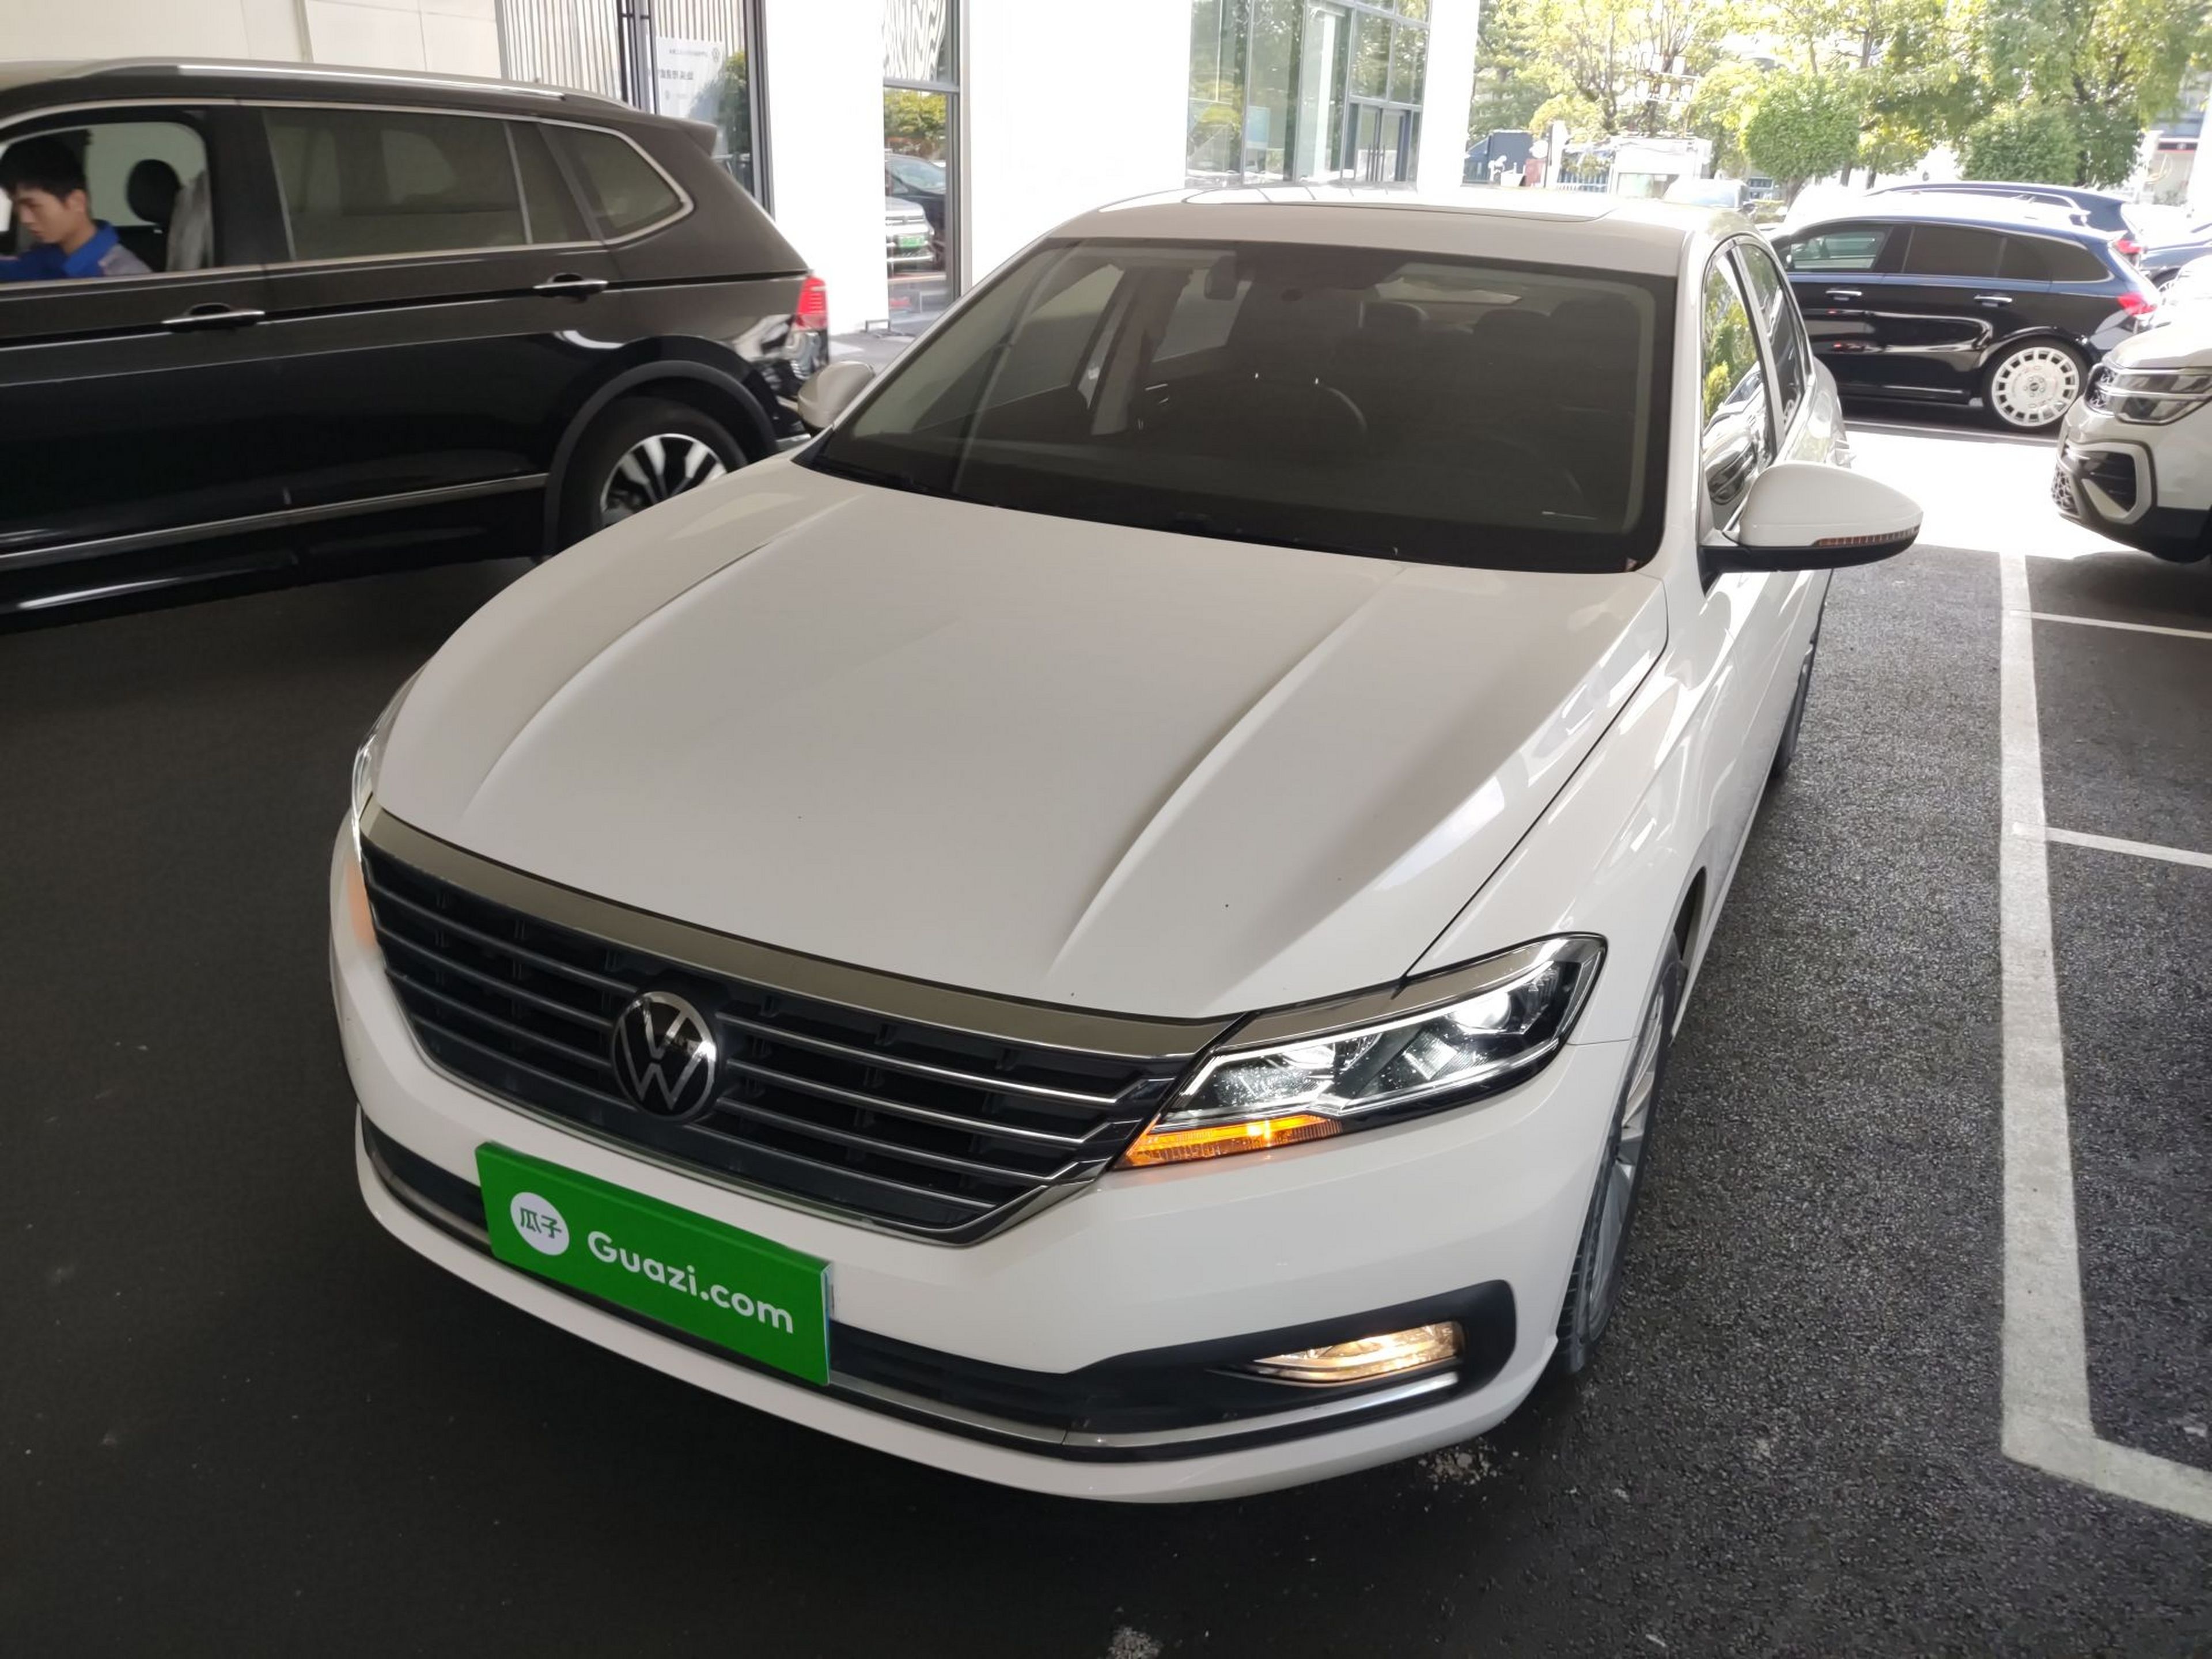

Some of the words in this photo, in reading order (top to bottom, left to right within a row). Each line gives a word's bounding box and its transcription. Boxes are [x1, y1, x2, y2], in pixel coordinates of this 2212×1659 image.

[614, 992, 715, 1116] VW
[520, 1207, 562, 1239] 瓜子
[588, 1230, 793, 1334] Guazi.com
